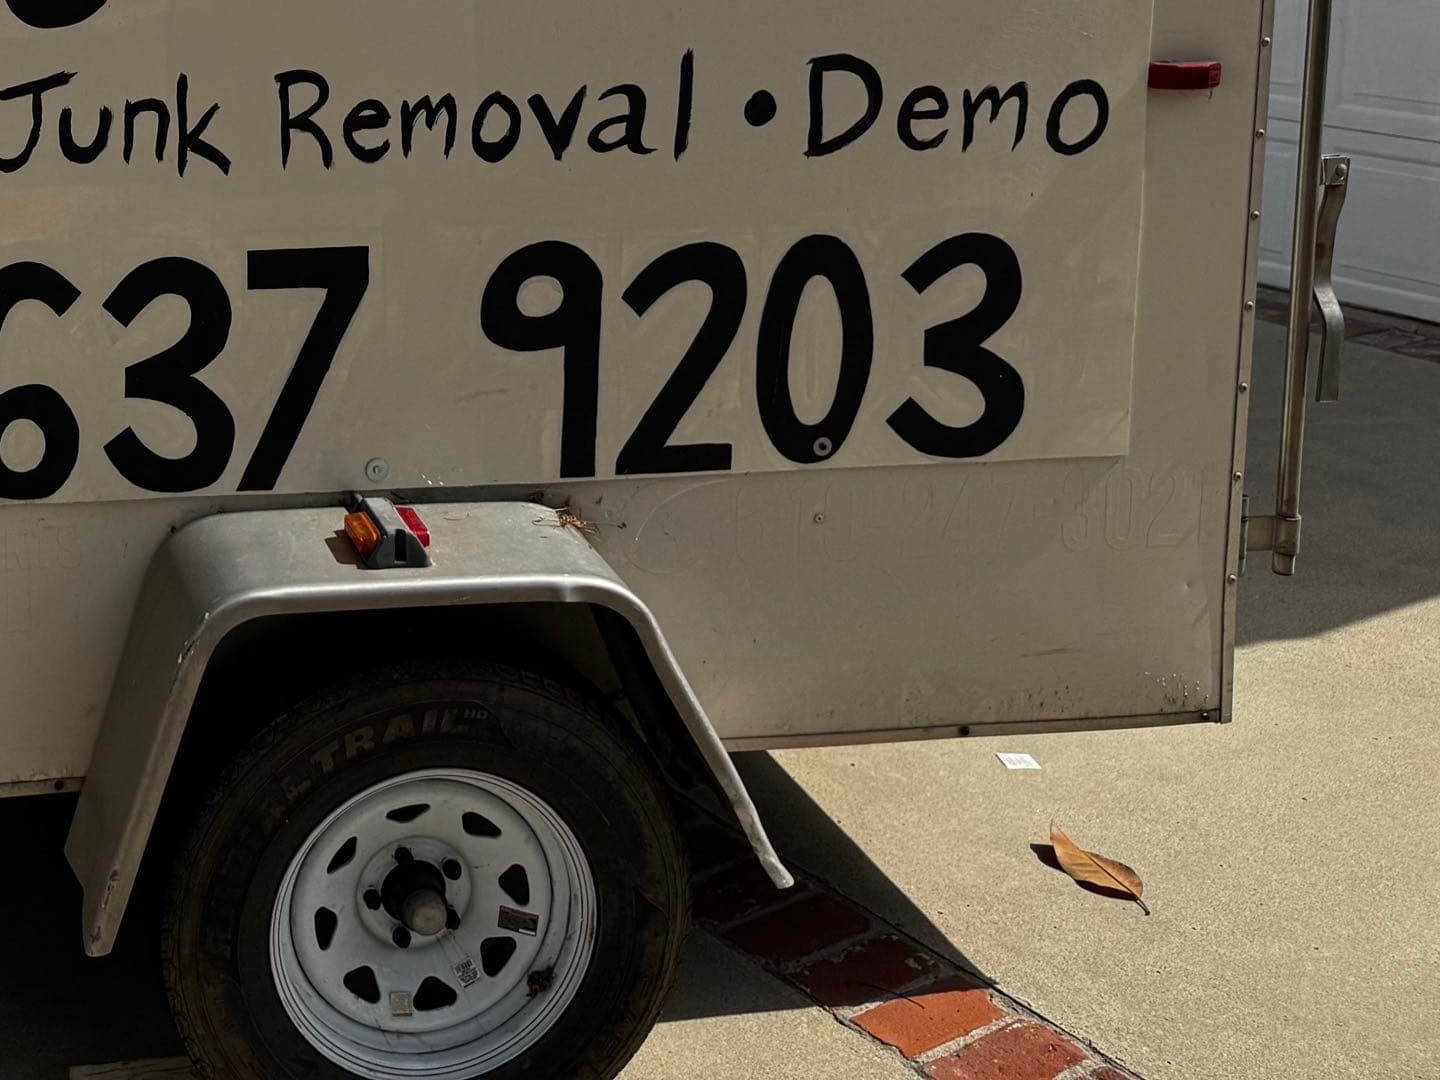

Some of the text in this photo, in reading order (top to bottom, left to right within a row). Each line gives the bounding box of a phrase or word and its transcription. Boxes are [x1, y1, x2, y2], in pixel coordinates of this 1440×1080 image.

[273, 47, 694, 172] Removal
[803, 53, 1110, 159] Demo
[480, 232, 1025, 479] 9203
